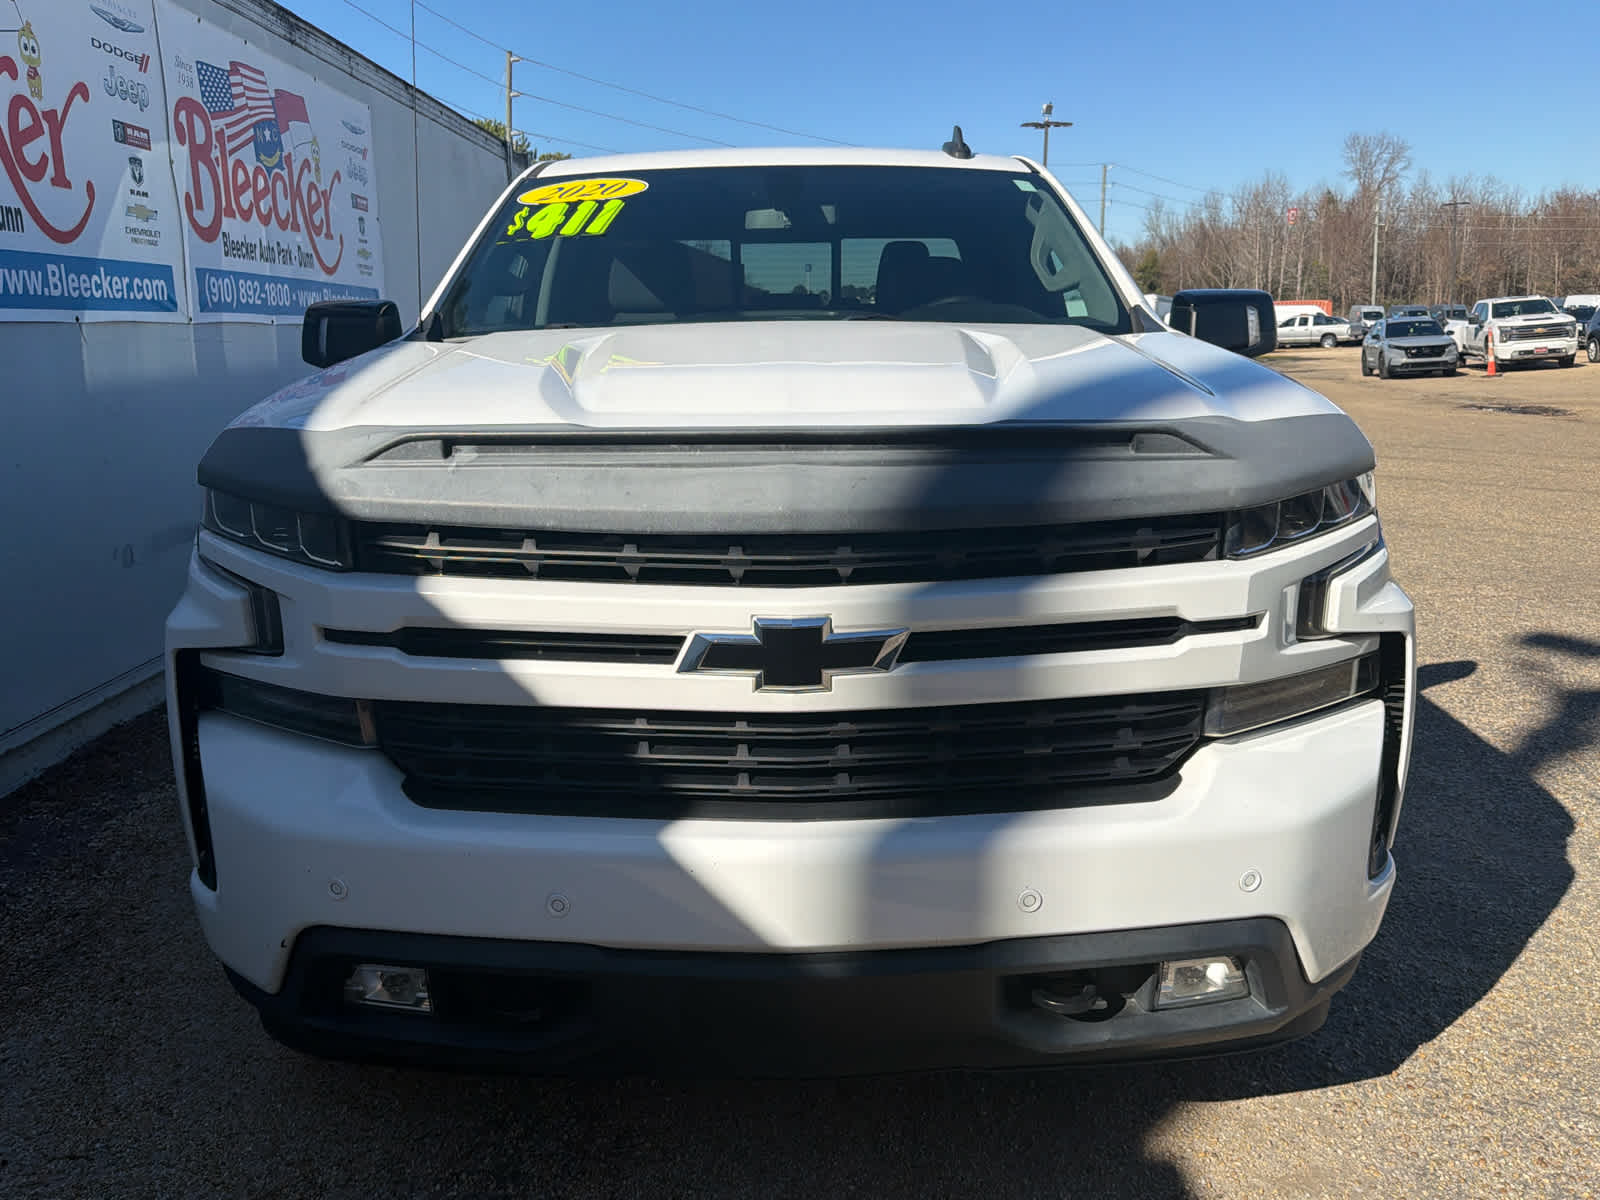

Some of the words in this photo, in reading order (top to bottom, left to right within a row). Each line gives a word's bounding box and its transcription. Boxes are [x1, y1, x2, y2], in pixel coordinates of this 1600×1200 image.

[91, 37, 144, 65] DODGE
[104, 65, 149, 112] Jeep
[130, 189, 149, 198] RAM
[173, 97, 344, 276] Bleecker
[535, 181, 629, 202] 2020
[125, 226, 160, 238] CHEVROLET
[507, 199, 626, 239] $411
[222, 231, 257, 261] Bleecker
[259, 238, 276, 264] Auto
[277, 241, 293, 266] Park
[297, 245, 314, 269] Dunn
[0, 263, 168, 301] ww.Bleecker.com
[205, 273, 237, 309] (910)
[238, 279, 290, 307] 892-1800
